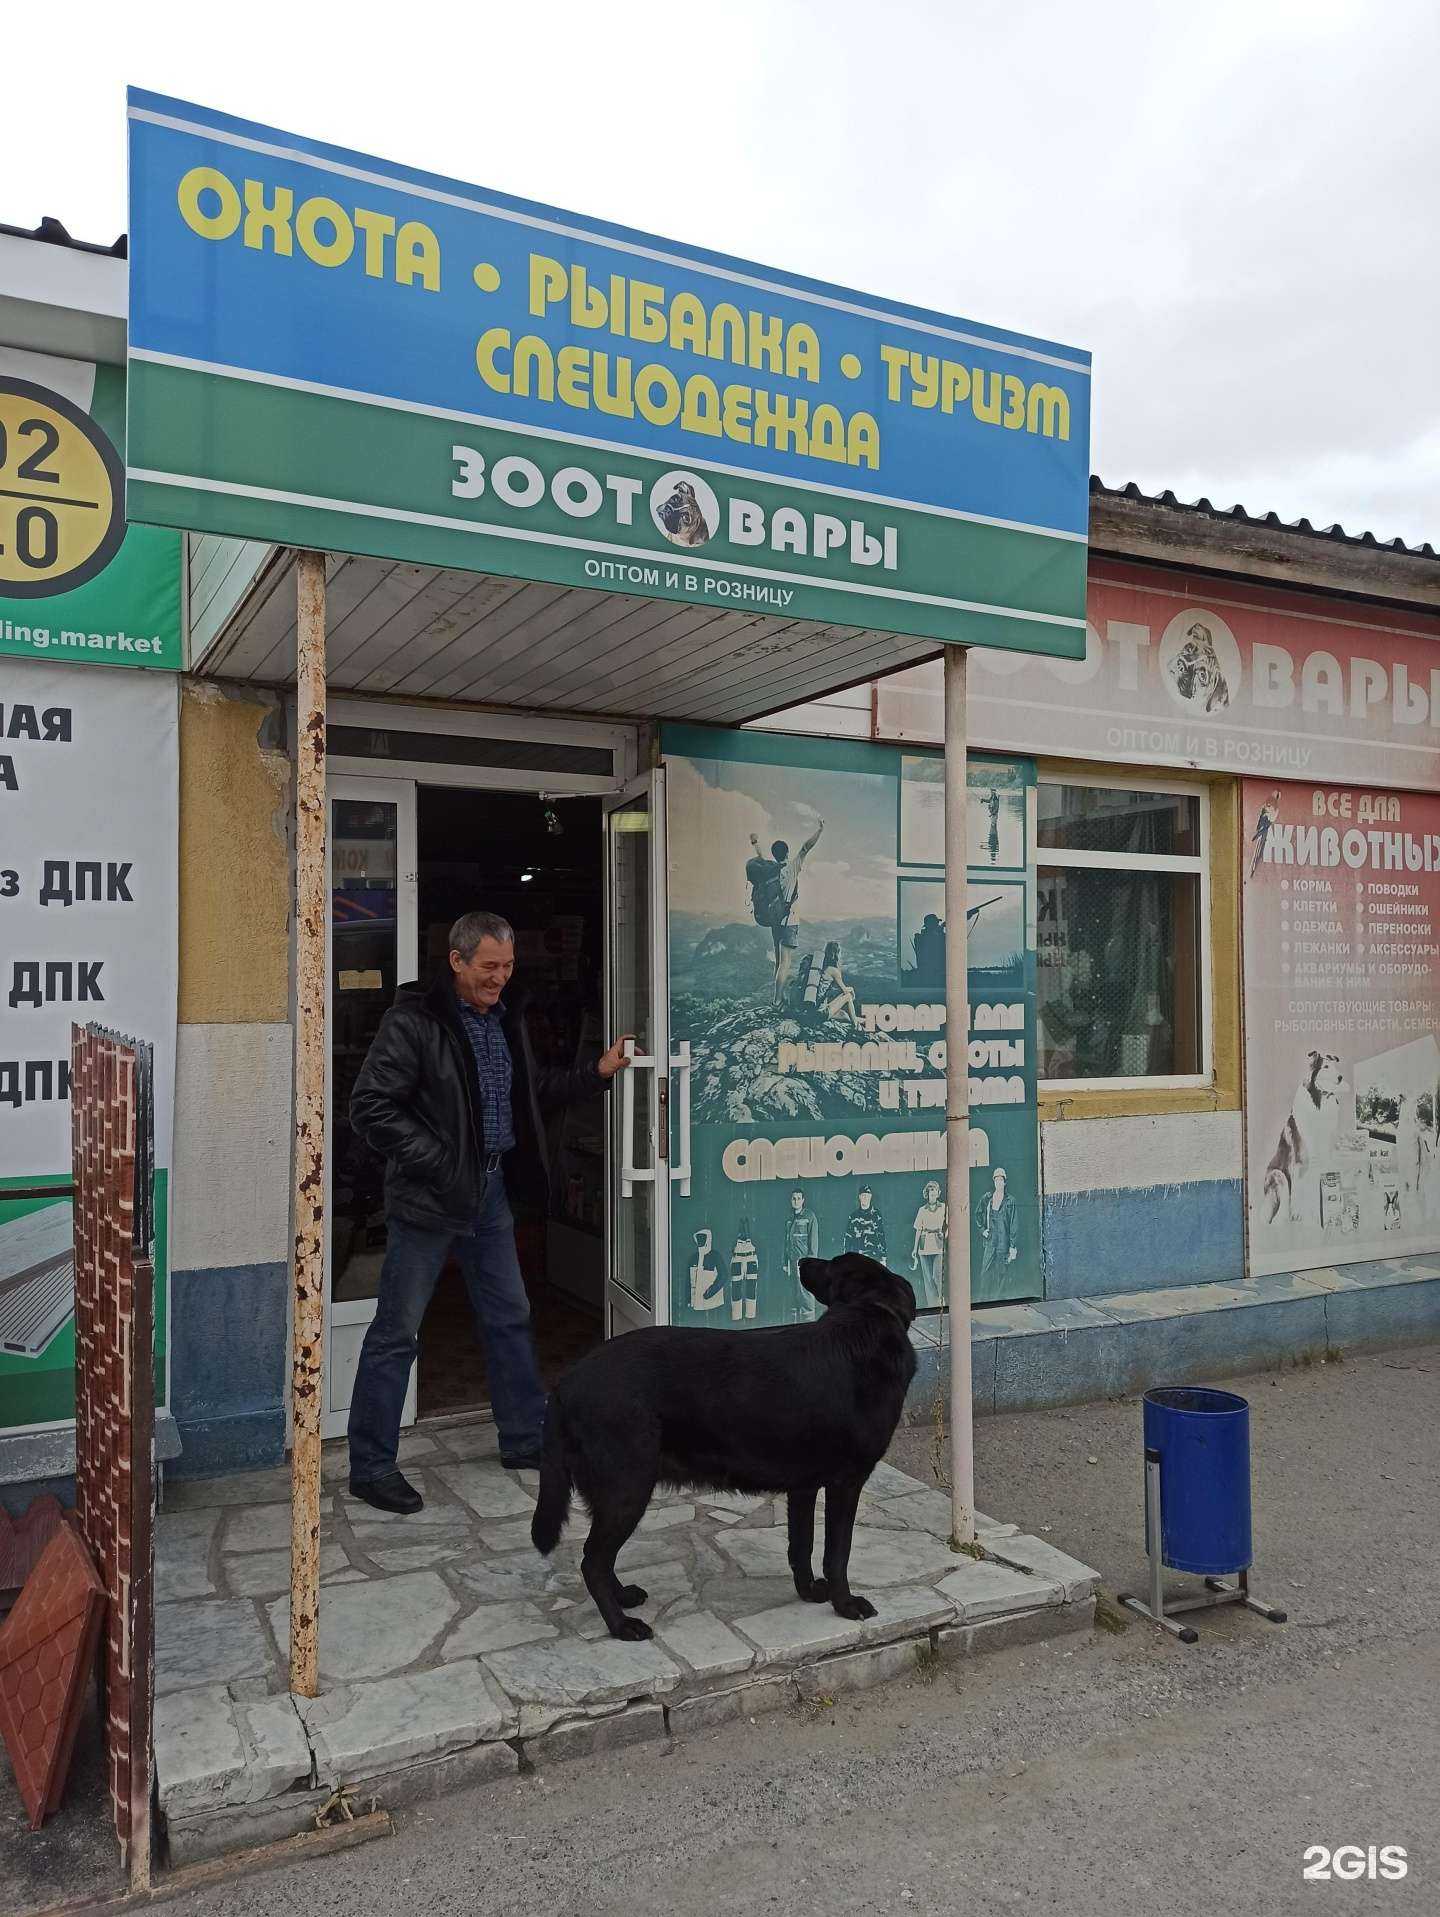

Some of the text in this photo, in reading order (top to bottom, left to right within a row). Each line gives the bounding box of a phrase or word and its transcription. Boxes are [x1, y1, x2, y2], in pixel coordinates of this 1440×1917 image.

[178, 166, 1071, 441] ОХОТА РЫБАЛКА ТУРИЗМ
[476, 327, 880, 471] СПЕЦОДЕЖДА
[0, 418, 59, 484] 2
[0, 506, 58, 569] 0
[584, 558, 794, 608] ОПТОМ И В РОЗНИЦУ
[0, 702, 72, 743] АЯ
[1106, 727, 1312, 768] ОПТОМ И В РОЗНИЦУ
[1312, 790, 1401, 825] ВСЕ ДЛЯ
[40, 860, 134, 907] ДПК
[1292, 879, 1333, 893] КОРМА
[1367, 882, 1419, 897] ПОВОДКИ
[1292, 899, 1338, 913] КЛЕТКИ
[1368, 901, 1429, 916] ОШЕЙНИКИ
[1293, 920, 1344, 934] ОДЕЖДА
[1368, 921, 1432, 936] ПЕРЕНОСКИ
[1294, 941, 1351, 954] ЛЕЖАНКИ
[1369, 942, 1440, 955] АКСЕССУАРЫ
[1295, 961, 1366, 975] АКВАРИУМЫ
[9, 962, 105, 1009] ДПК
[861, 1003, 971, 1032] ТОВАР
[1288, 1000, 1386, 1015] СОПУТСТВУЮЩИЕ
[1274, 1018, 1355, 1032] РЫБОЛОВНЫЕ
[928, 1038, 1025, 1070] ООТЫ
[903, 1075, 1026, 1109] ТУРЗМА
[722, 1127, 990, 1183] СПЕЦОДЕЖА
